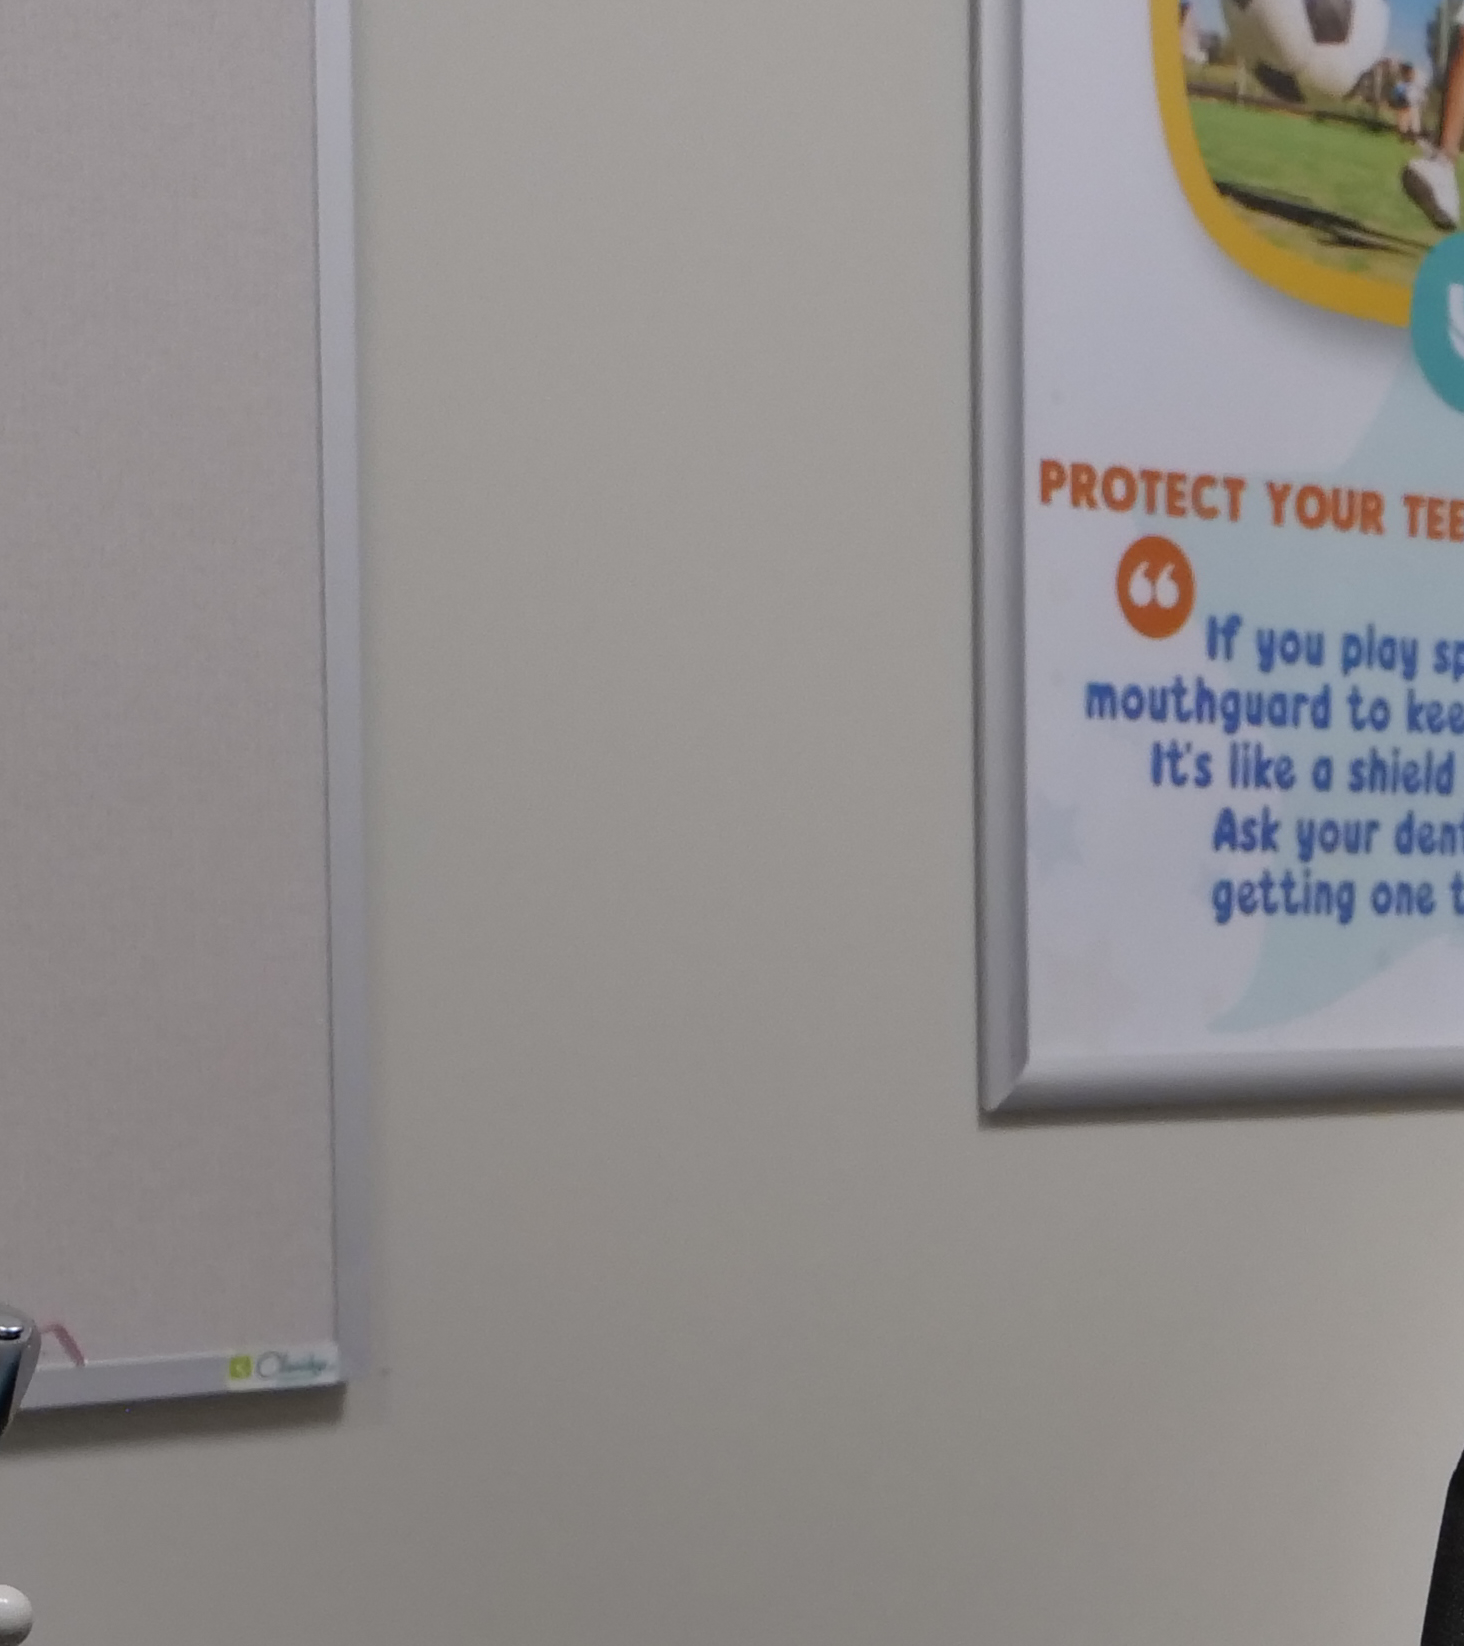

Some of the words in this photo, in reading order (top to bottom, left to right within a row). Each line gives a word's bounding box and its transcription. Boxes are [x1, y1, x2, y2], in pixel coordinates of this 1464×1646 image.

[1041, 460, 1245, 521] PROTECT
[1269, 484, 1383, 534] YOUR
[1207, 614, 1241, 660] If
[1255, 629, 1325, 676] you
[1341, 622, 1417, 684] play
[1085, 678, 1331, 734] mouthguard
[1347, 688, 1391, 734] to
[1151, 743, 1212, 790] It's
[1231, 746, 1297, 792] like
[1311, 755, 1334, 793] a
[1348, 749, 1457, 800] shield
[1212, 806, 1279, 854] Ask
[1297, 818, 1380, 866] your
[1212, 872, 1356, 926] getting
[1371, 880, 1436, 919] one
